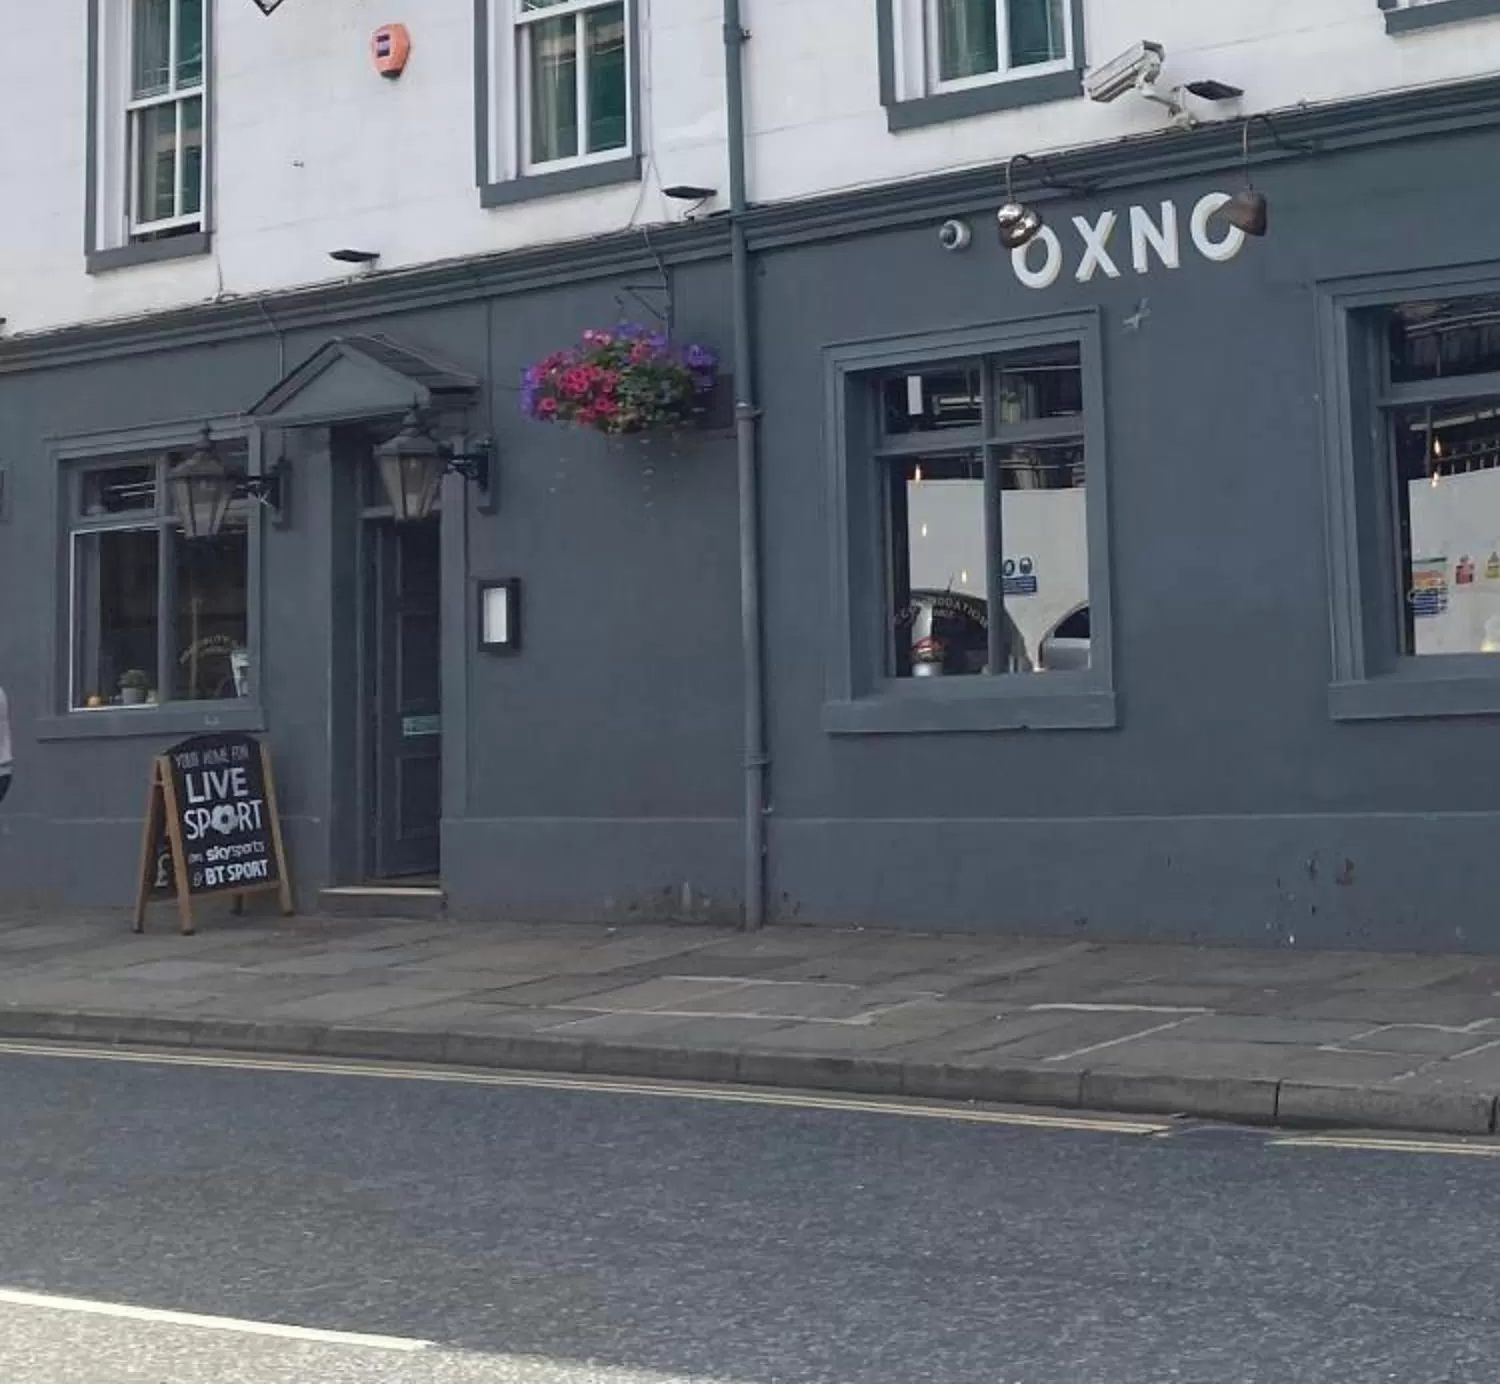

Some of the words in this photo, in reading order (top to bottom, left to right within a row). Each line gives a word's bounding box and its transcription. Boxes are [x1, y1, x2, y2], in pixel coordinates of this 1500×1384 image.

[185, 768, 249, 803] LIVE
[184, 800, 263, 840] SPORT
[205, 866, 224, 885] BT
[227, 859, 268, 881] SPORT
